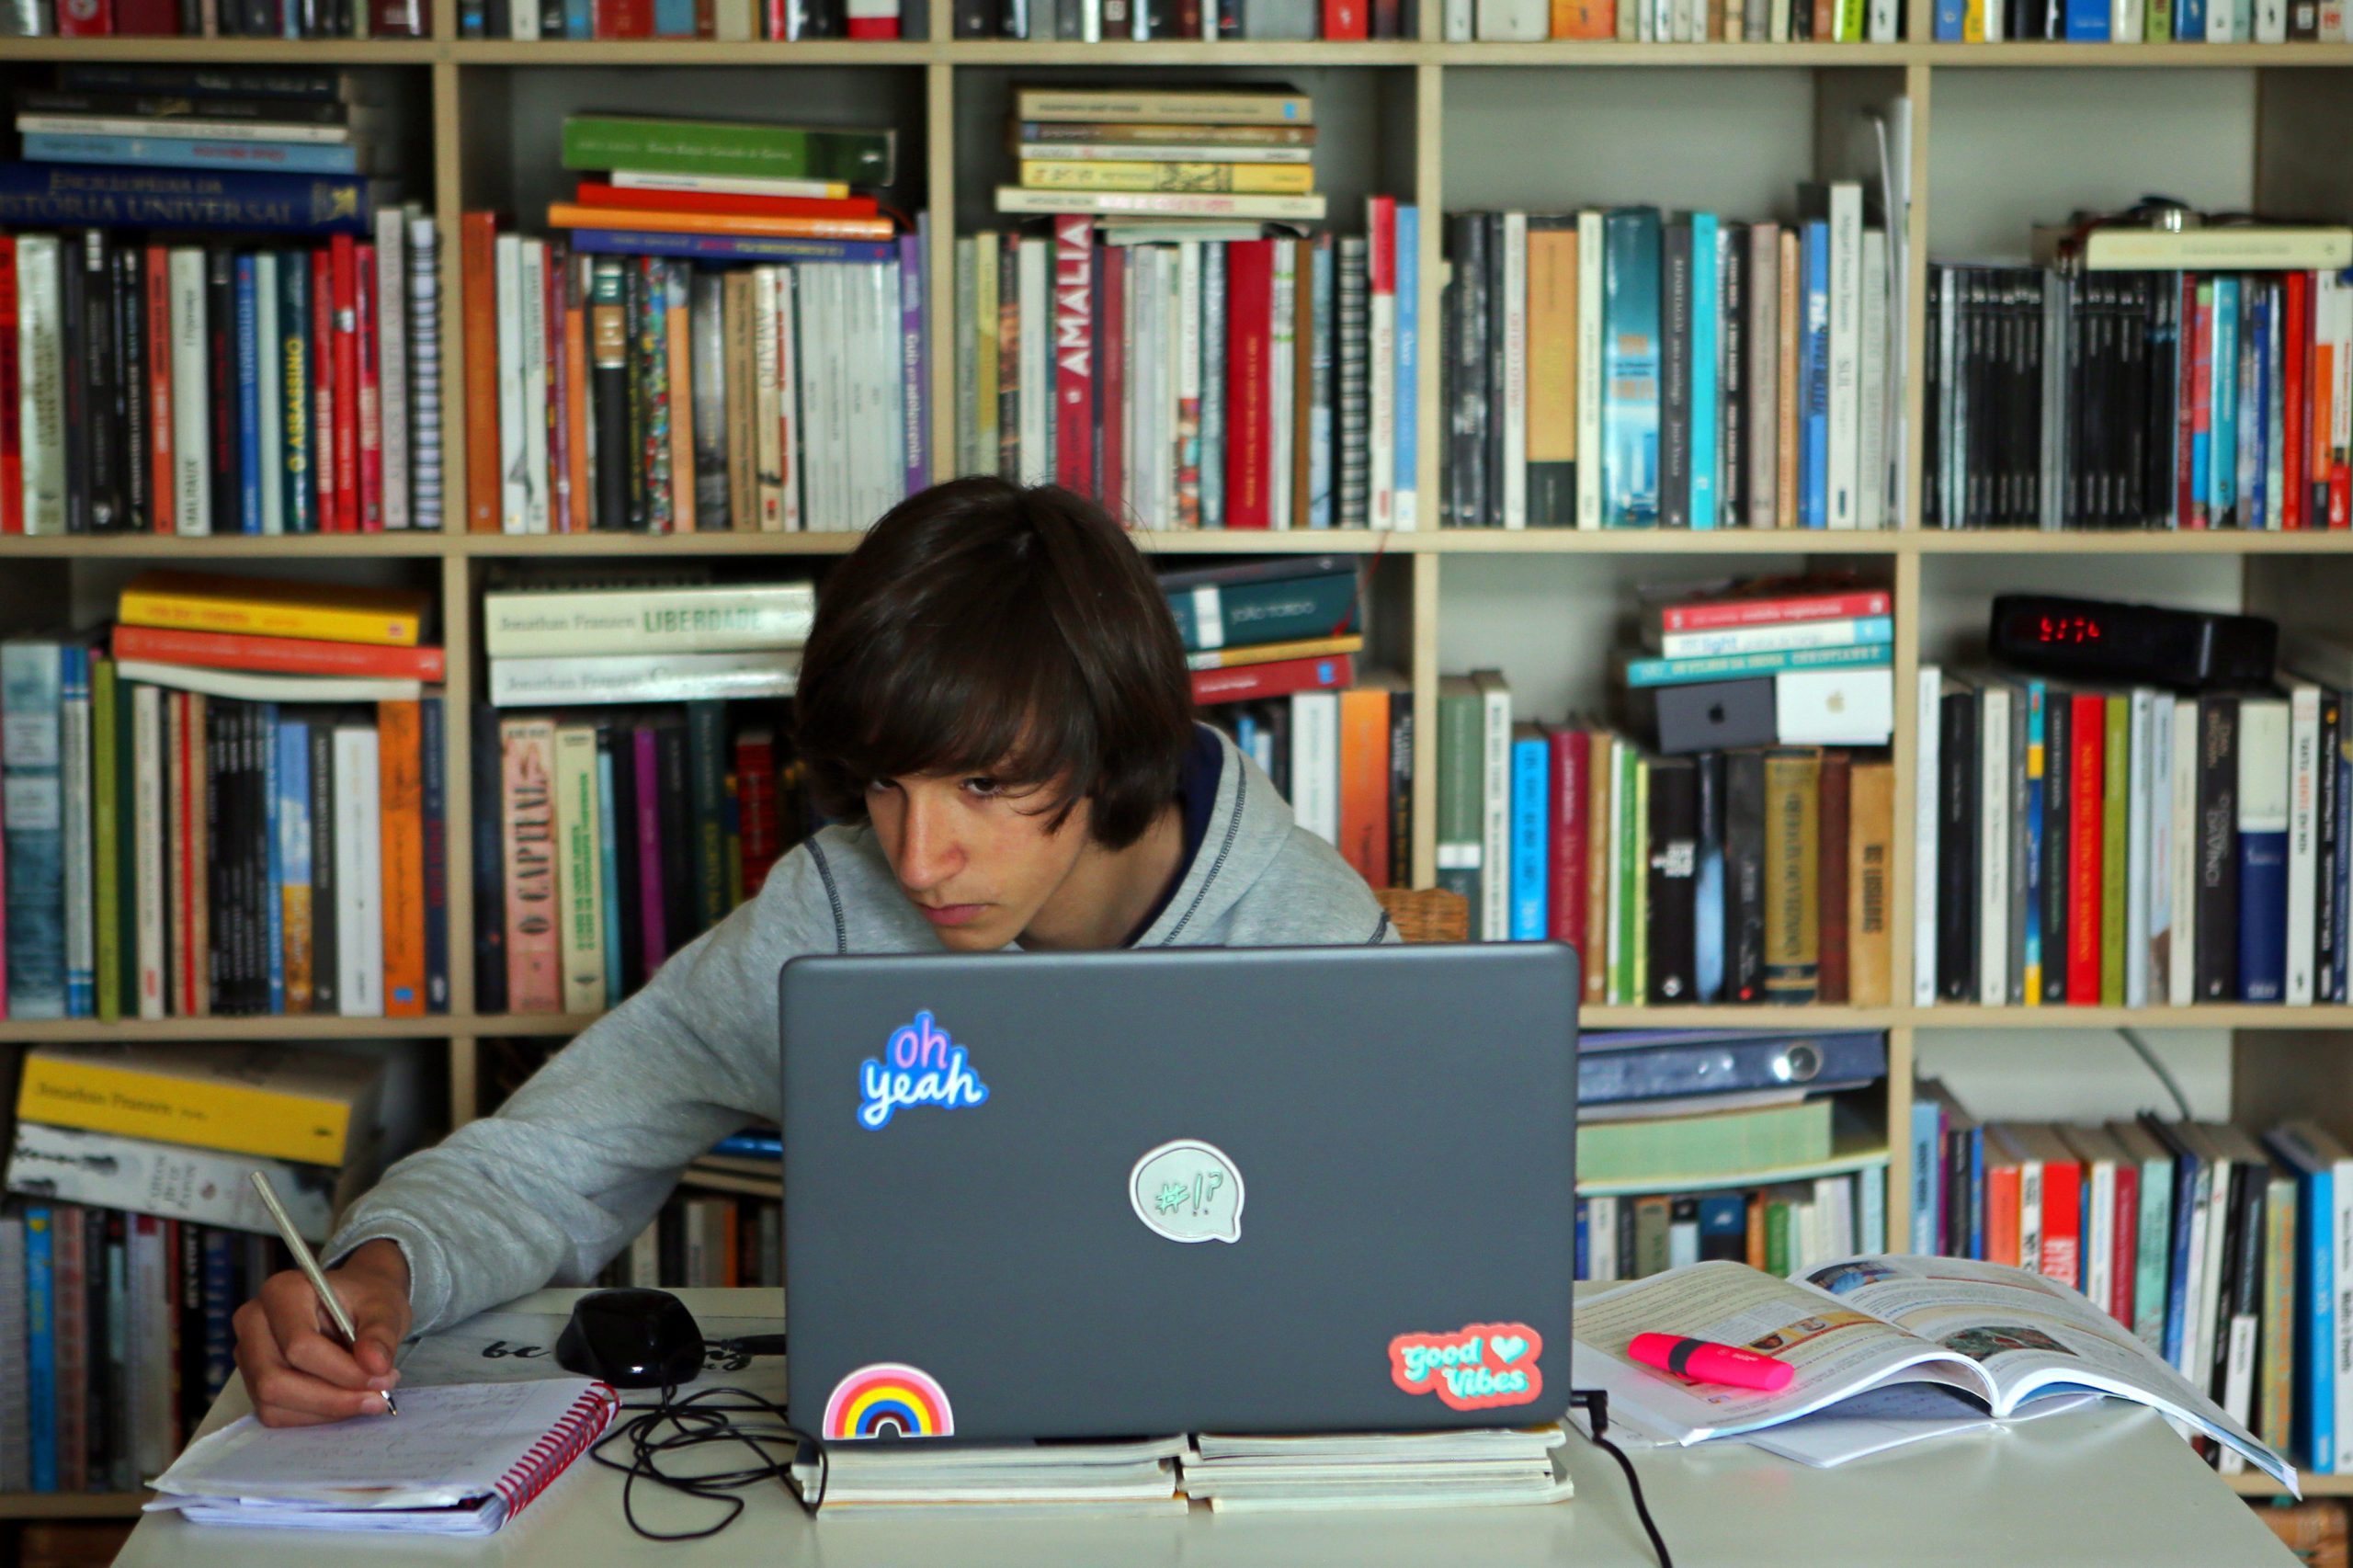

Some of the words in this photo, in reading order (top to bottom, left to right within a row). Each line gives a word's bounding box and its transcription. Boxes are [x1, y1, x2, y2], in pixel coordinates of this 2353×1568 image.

[285, 335, 306, 449] ASSASSINO
[906, 383, 923, 469] adolescentes
[643, 607, 761, 634] LIBERDADE
[2206, 710, 2221, 768] BROWN
[2217, 720, 2232, 757] DAN
[514, 780, 550, 903] CAPITAL
[515, 915, 550, 937] O
[895, 1017, 948, 1070] oh
[863, 1050, 984, 1127] yeah
[1400, 1335, 1484, 1383] good
[1441, 1366, 1530, 1399] Vibes
